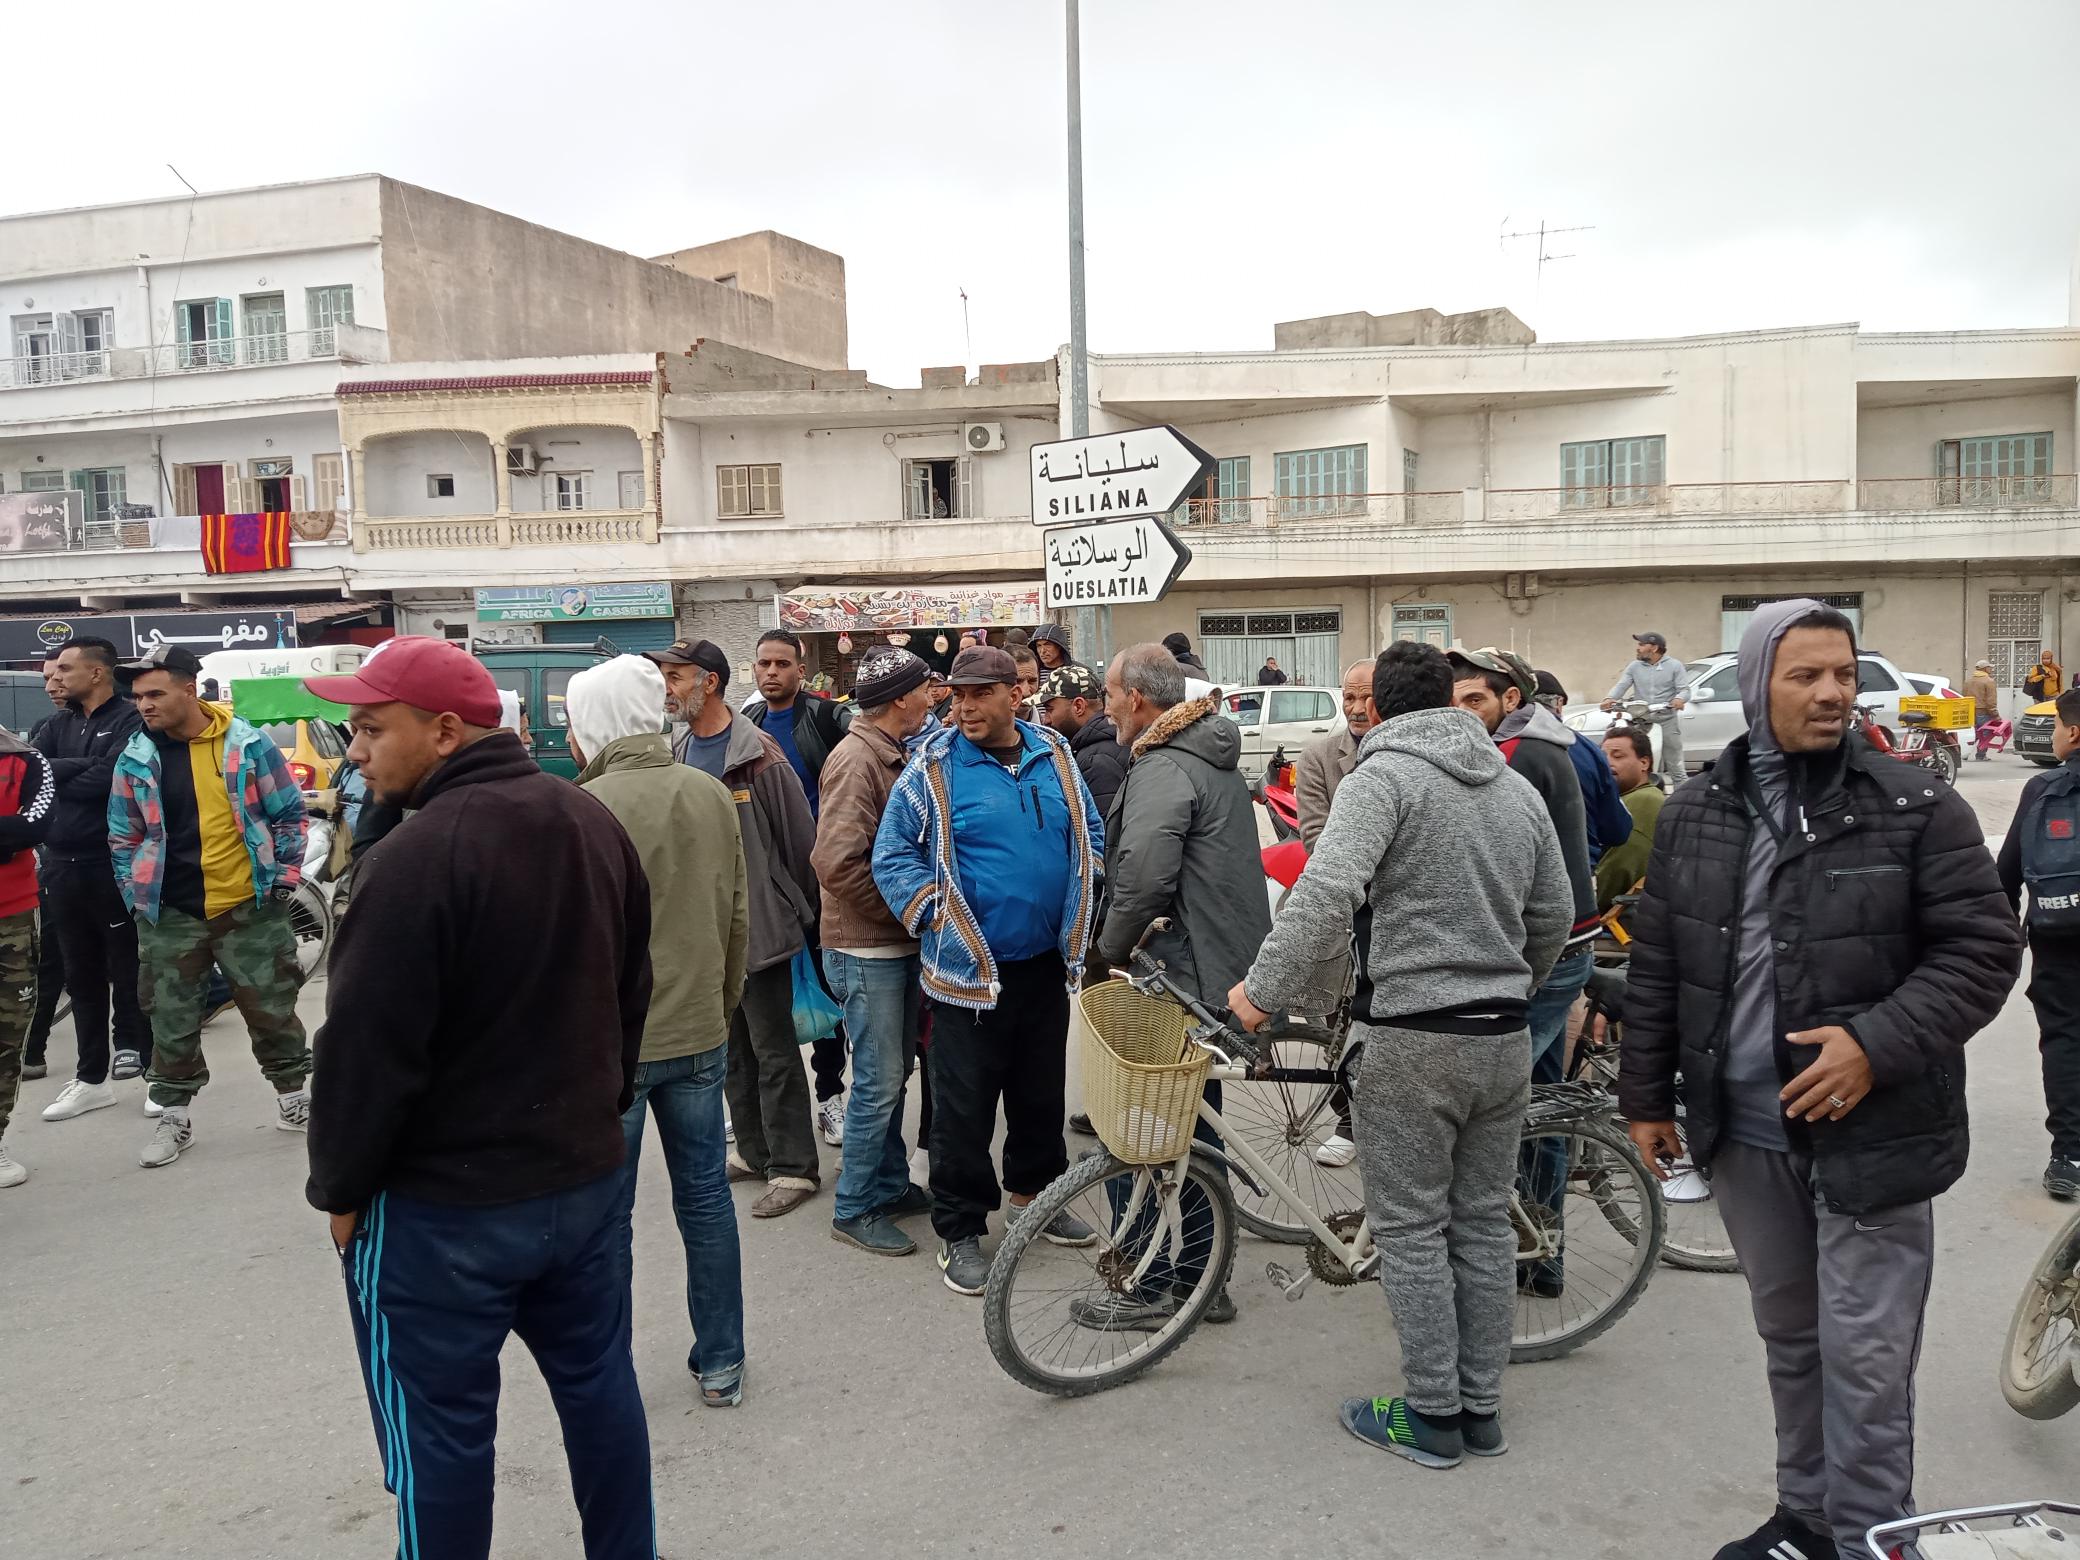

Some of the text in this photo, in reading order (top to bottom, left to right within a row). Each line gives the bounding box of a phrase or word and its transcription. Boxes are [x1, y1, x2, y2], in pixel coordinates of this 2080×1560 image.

[1038, 440, 1159, 485] سليانة
[1049, 488, 1149, 516] SILIANA
[1049, 526, 1149, 577] الوسلاتية
[1052, 576, 1149, 600] OUESLATIA
[501, 606, 668, 620] AFRICA CASSETTE
[2037, 895, 2070, 910] FREE
